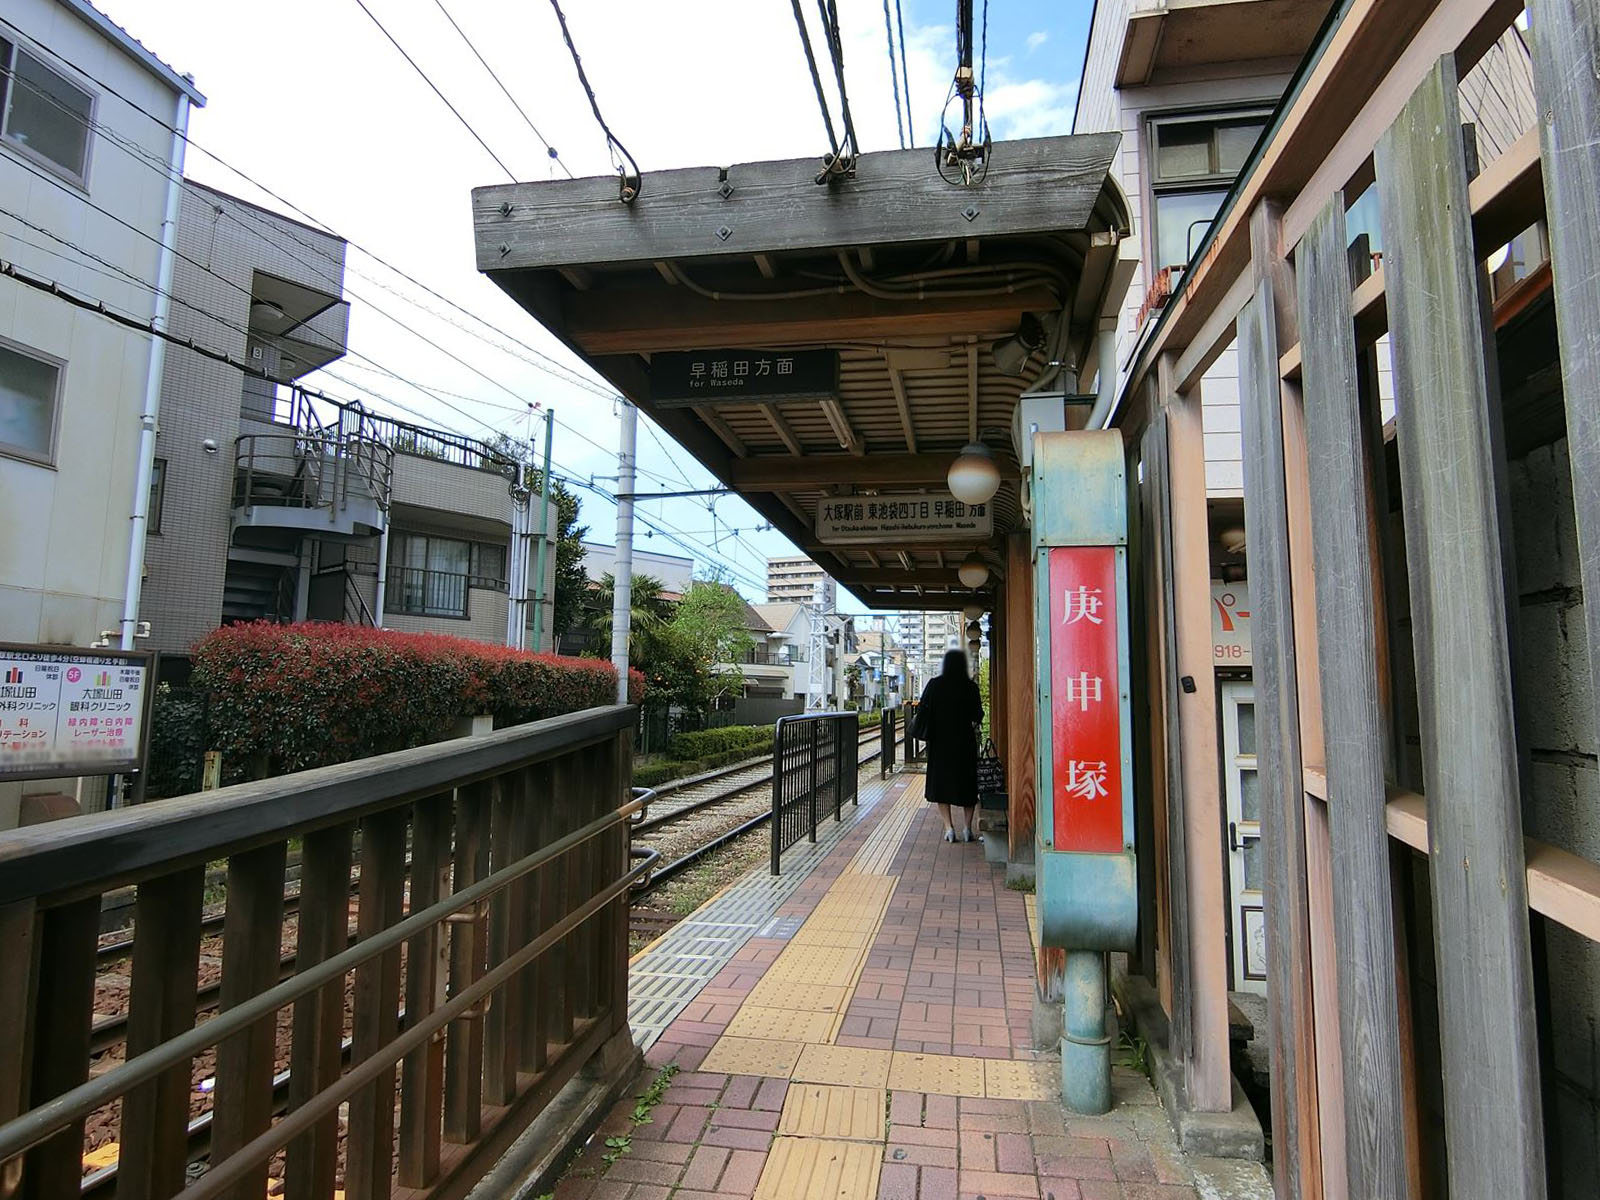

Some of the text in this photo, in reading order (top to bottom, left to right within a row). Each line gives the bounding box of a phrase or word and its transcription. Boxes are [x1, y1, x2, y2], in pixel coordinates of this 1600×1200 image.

[690, 358, 794, 378] 早稲田方面
[710, 379, 744, 387] Waseda
[824, 504, 864, 521] 大塚駅前
[868, 502, 928, 520] 東池袋四丁目
[934, 501, 965, 518] 早稲田
[82, 689, 123, 700] 大塚山田
[1062, 585, 1109, 800] 庚申塚
[70, 702, 131, 712] 眼科クリニック
